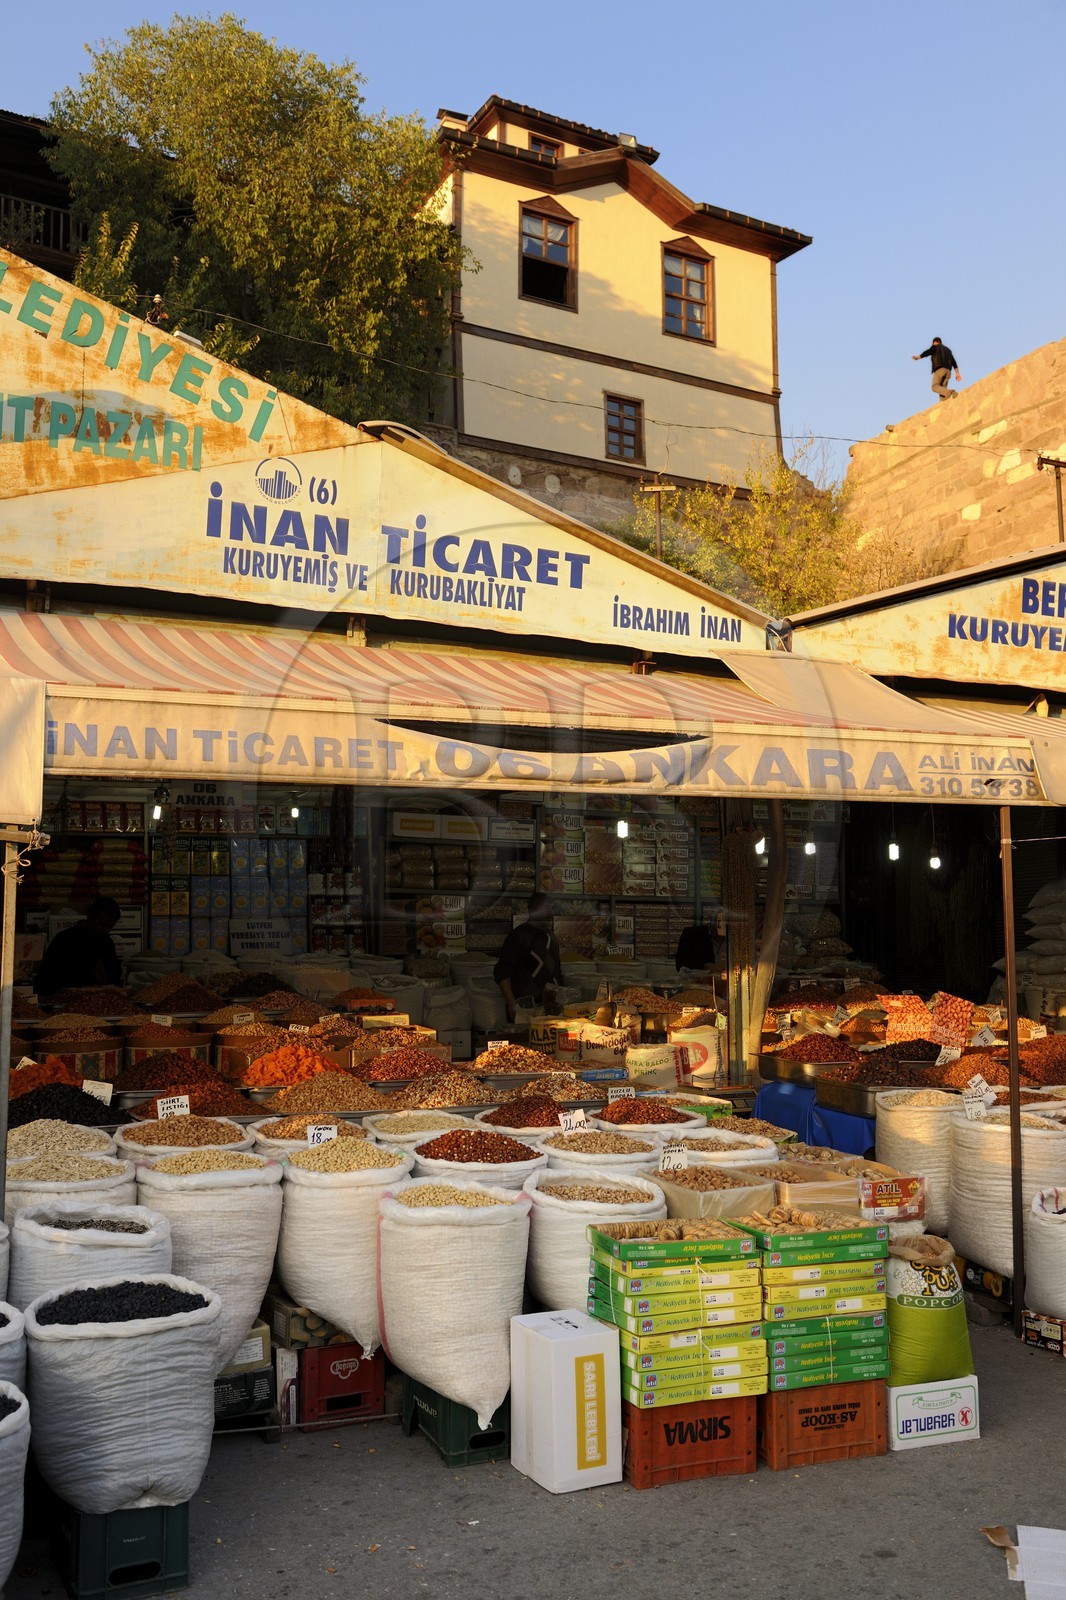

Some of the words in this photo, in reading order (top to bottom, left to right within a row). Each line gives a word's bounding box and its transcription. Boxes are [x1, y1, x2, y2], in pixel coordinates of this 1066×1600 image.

[49, 400, 204, 472] PAZARI
[309, 476, 338, 505] (6)
[206, 481, 350, 556] İNAN
[381, 514, 591, 590] TİCARET
[223, 545, 339, 594] KURUYEMİŞ
[346, 564, 369, 592] VE
[390, 569, 526, 612] KURUBAKLİYAT
[700, 606, 742, 643] İNAN
[948, 613, 1066, 653] KURUYE
[47, 720, 178, 762] İNAN
[192, 729, 404, 771] TİCARET
[569, 744, 914, 792] ANKARA
[176, 795, 235, 806] ANKARA
[193, 783, 217, 794] 06
[920, 776, 962, 797] 310
[1008, 778, 1040, 798] 38
[564, 869, 582, 881] EKOL
[444, 896, 463, 909] EKOL
[446, 924, 464, 936] EKOL
[618, 919, 633, 930] EKOL
[877, 1183, 901, 1194] ATIL
[583, 1360, 597, 1399] SARI
[584, 1400, 602, 1463] LEBLEBİ
[664, 1416, 732, 1447] SIRMA
